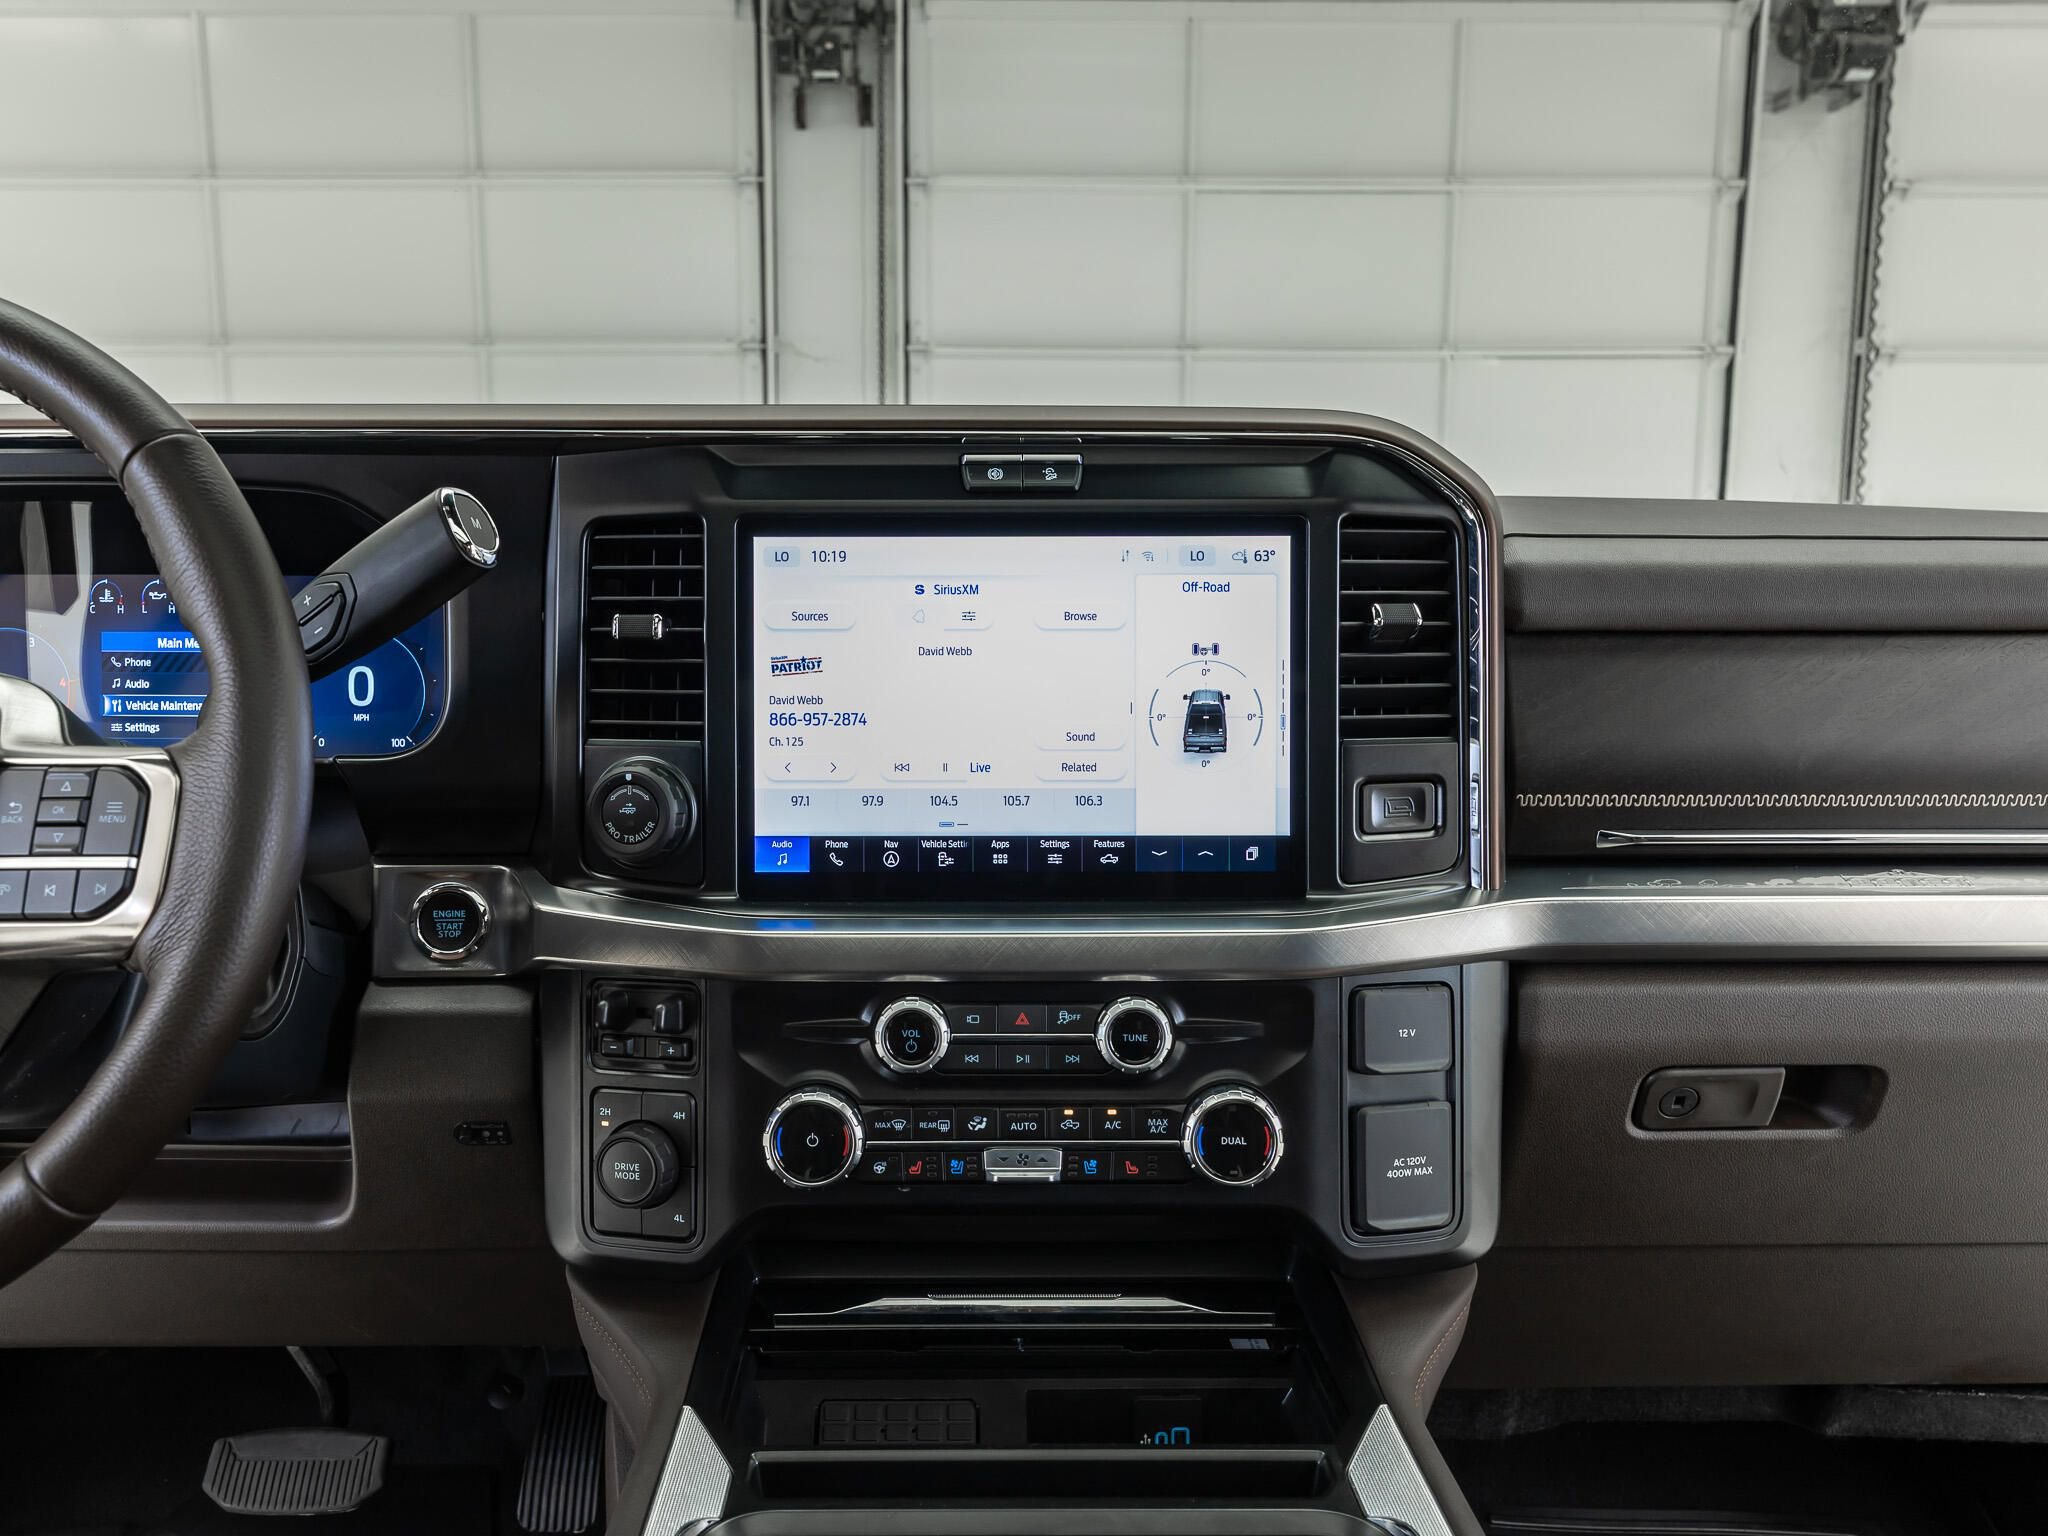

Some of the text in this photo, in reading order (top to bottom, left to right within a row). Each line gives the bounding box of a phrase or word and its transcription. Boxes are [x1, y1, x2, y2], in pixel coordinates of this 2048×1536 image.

[773, 550, 790, 563] LO
[811, 550, 847, 563] 10:19
[1189, 550, 1206, 563] LO
[1254, 549, 1276, 562] 63°
[933, 584, 980, 596] SiriusXM
[1181, 581, 1230, 593] Off-Road
[90, 604, 95, 613] C
[117, 605, 124, 613] H
[142, 605, 147, 613] L
[169, 605, 175, 613] H
[791, 610, 829, 622] Sources
[1063, 610, 1097, 622] Browse
[157, 638, 182, 649] Main
[918, 646, 973, 657] David Webb
[125, 658, 151, 667] Phone
[771, 659, 823, 674] PATRIOT
[1201, 668, 1211, 677] 0°
[125, 679, 149, 688] Audio
[347, 665, 375, 707] 0
[768, 695, 824, 705] David Webb
[125, 700, 158, 711] Vehicle
[768, 712, 868, 727] 866-957-2874
[1157, 713, 1167, 722] 0°
[1247, 713, 1257, 722] 0°
[124, 723, 160, 732] Settings
[768, 737, 804, 747] Ch. 125
[1065, 732, 1096, 742] Sound
[318, 738, 325, 747] 0
[391, 738, 405, 748] 100
[969, 762, 992, 774] Live
[1060, 762, 1097, 773] Related
[1201, 759, 1211, 768] 0°
[790, 795, 810, 808] 97.1
[861, 795, 884, 808] 97.9
[929, 795, 958, 808] 104.5
[1003, 795, 1031, 808] 105.7
[1074, 795, 1103, 808] 106.3
[52, 806, 65, 814] OK
[98, 815, 126, 823] MENU
[605, 821, 656, 843] PRO TRAILER
[771, 840, 793, 849] Audio
[824, 840, 849, 849] Phone
[884, 840, 899, 849] Nav
[921, 840, 944, 849] Vehicle
[991, 840, 1010, 850] Apps
[1039, 840, 1070, 851] Settings
[1093, 840, 1125, 849] Features
[1068, 1013, 1081, 1022] OFF
[901, 1029, 921, 1039] VOL
[1122, 1033, 1149, 1043] TUNE
[1398, 1029, 1416, 1038] 12 V
[599, 1107, 611, 1117] 2H
[673, 1111, 686, 1121] 4H
[875, 1120, 891, 1130] MAX
[919, 1121, 937, 1130] REAR
[1010, 1121, 1038, 1132] AUTO
[1104, 1120, 1122, 1129] A/C
[1147, 1118, 1169, 1126] MAX
[1150, 1125, 1167, 1134] A/C
[1220, 1135, 1248, 1146] DUAL
[1393, 1156, 1427, 1167] AC 120V
[614, 1163, 640, 1171] DRIVE
[1386, 1166, 1433, 1178] 400W MAX
[614, 1171, 641, 1180] MODE
[673, 1214, 685, 1222] 4L
